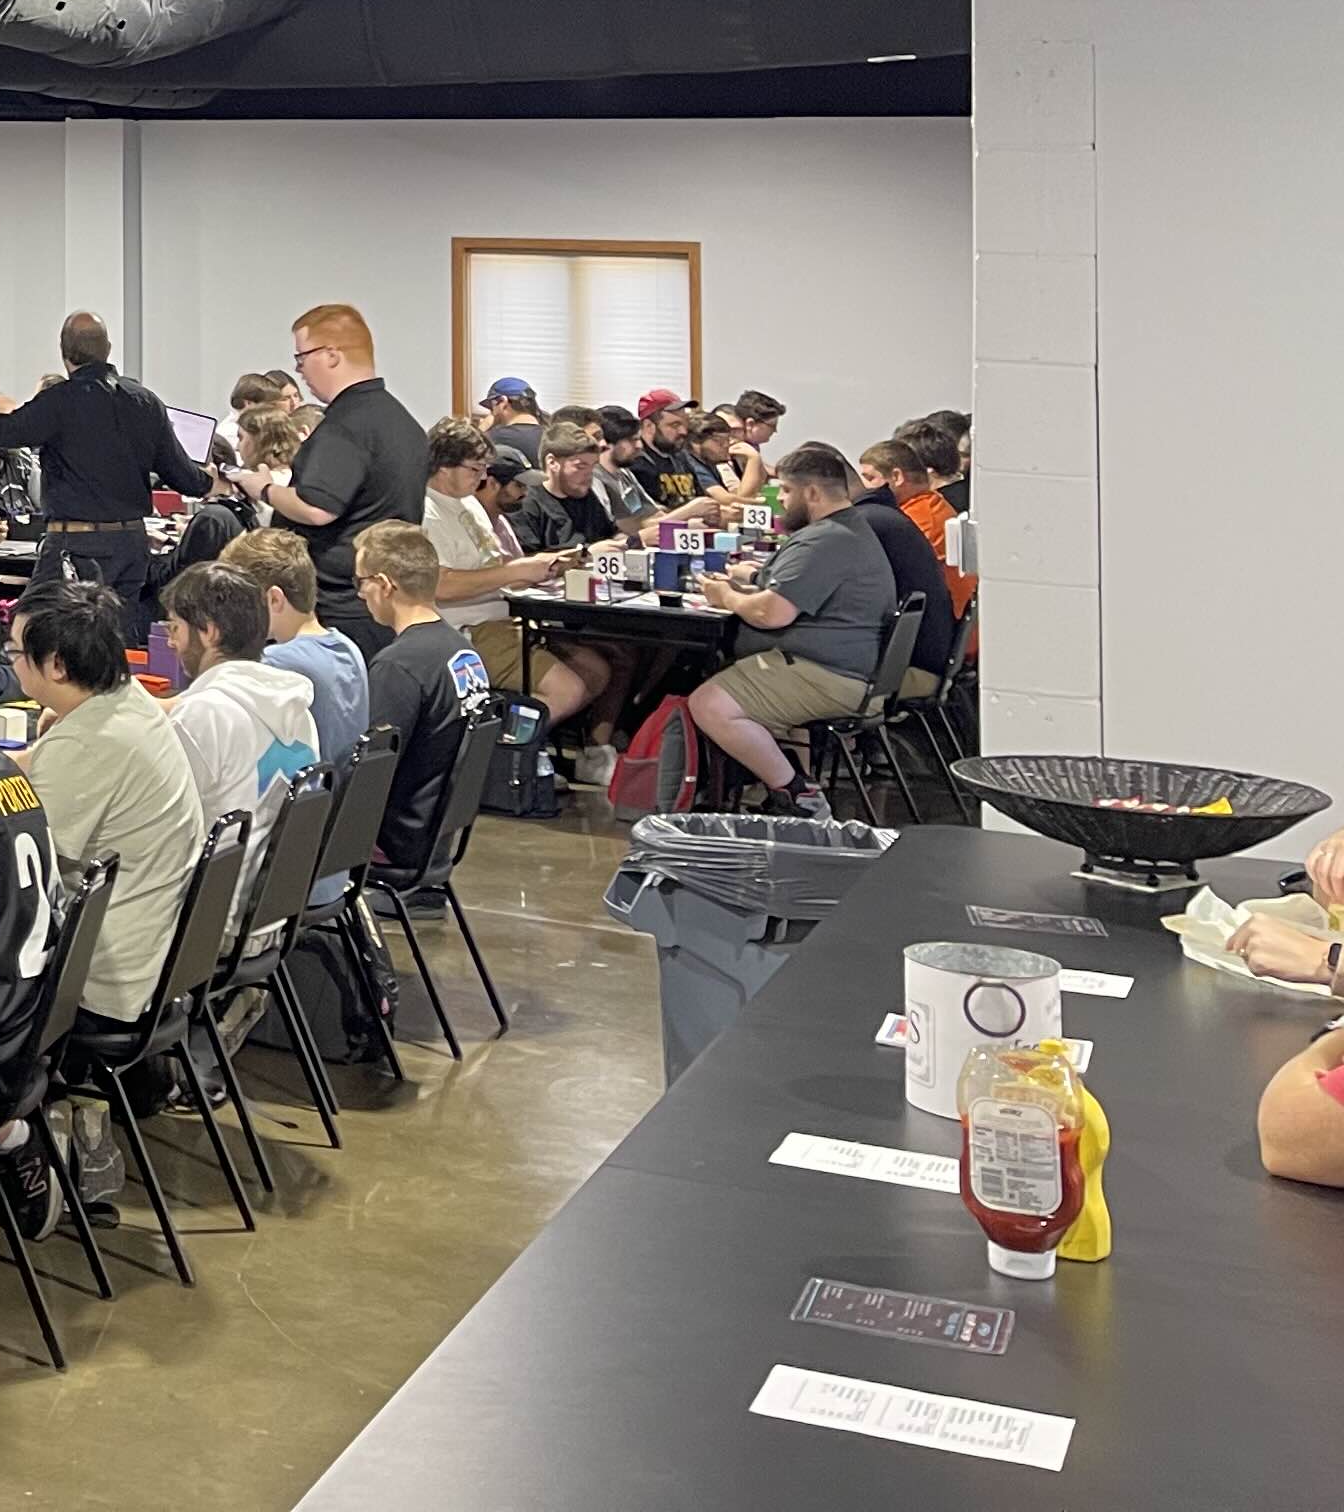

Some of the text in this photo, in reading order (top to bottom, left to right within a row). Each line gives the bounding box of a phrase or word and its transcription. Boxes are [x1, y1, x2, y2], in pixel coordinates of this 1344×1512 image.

[747, 509, 767, 526] 33
[679, 532, 700, 550] 35
[597, 555, 619, 575] 36
[14, 827, 65, 979] 2
